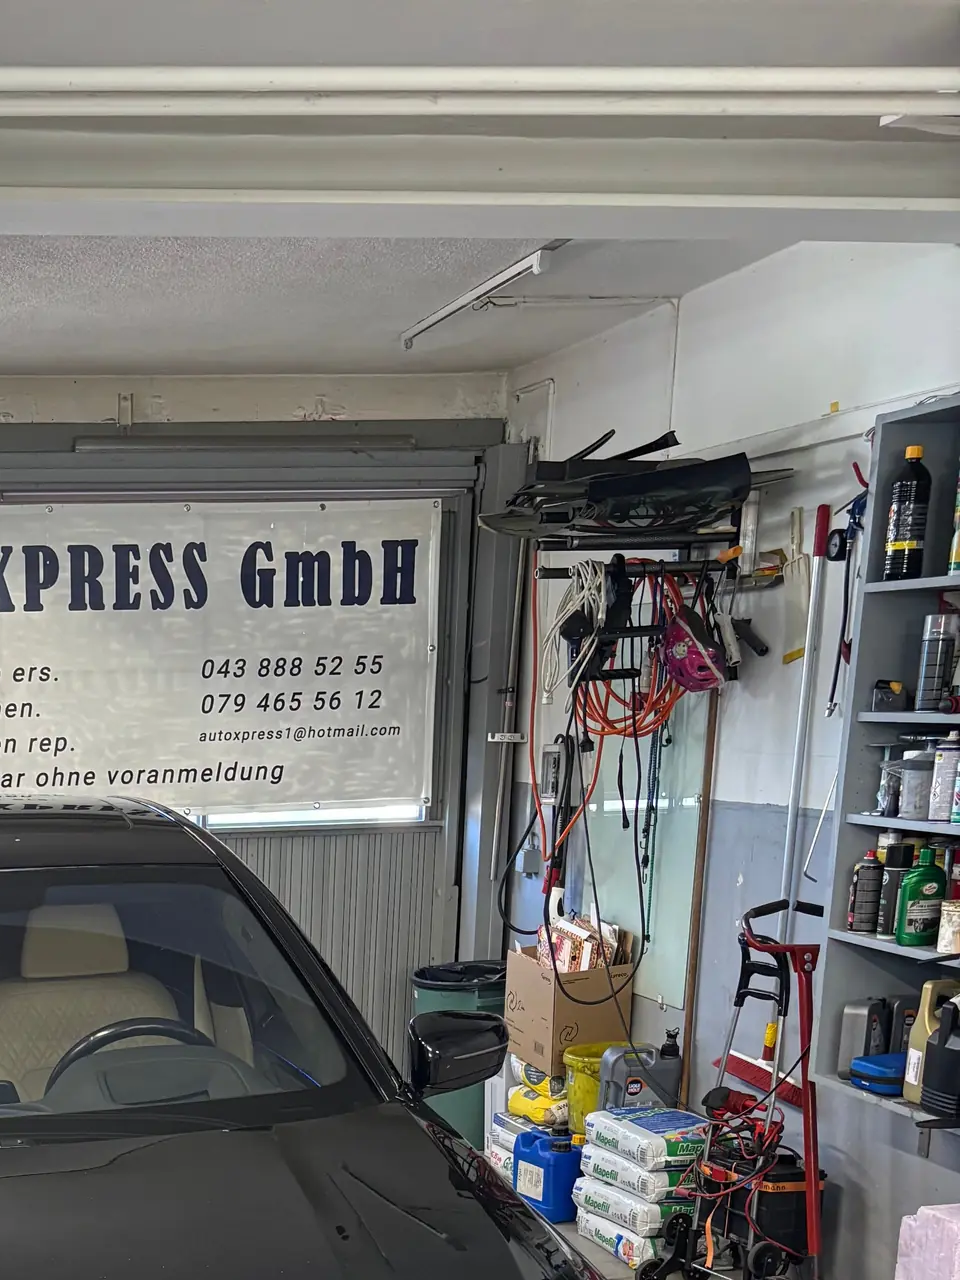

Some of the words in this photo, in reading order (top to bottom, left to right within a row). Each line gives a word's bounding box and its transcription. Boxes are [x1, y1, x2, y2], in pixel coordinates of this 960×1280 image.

[240, 539, 419, 608] GmbH
[12, 665, 59, 683] ers.
[201, 658, 247, 679] 043
[257, 657, 303, 678] 888
[313, 656, 343, 677] 52
[353, 655, 384, 675] 55
[201, 693, 246, 714] 079
[256, 692, 303, 712] 465
[313, 691, 341, 711] 56
[354, 689, 382, 710] 12
[199, 724, 401, 743] autoxpress1@hotmail.com
[28, 736, 76, 757] rep.
[36, 766, 96, 787] ohne
[108, 761, 285, 785] voranmeldung
[595, 1131, 619, 1150] Mapefill
[592, 1163, 619, 1182] Mapefill
[583, 1195, 611, 1216] Mapefill
[594, 1228, 616, 1249] Mapefill
